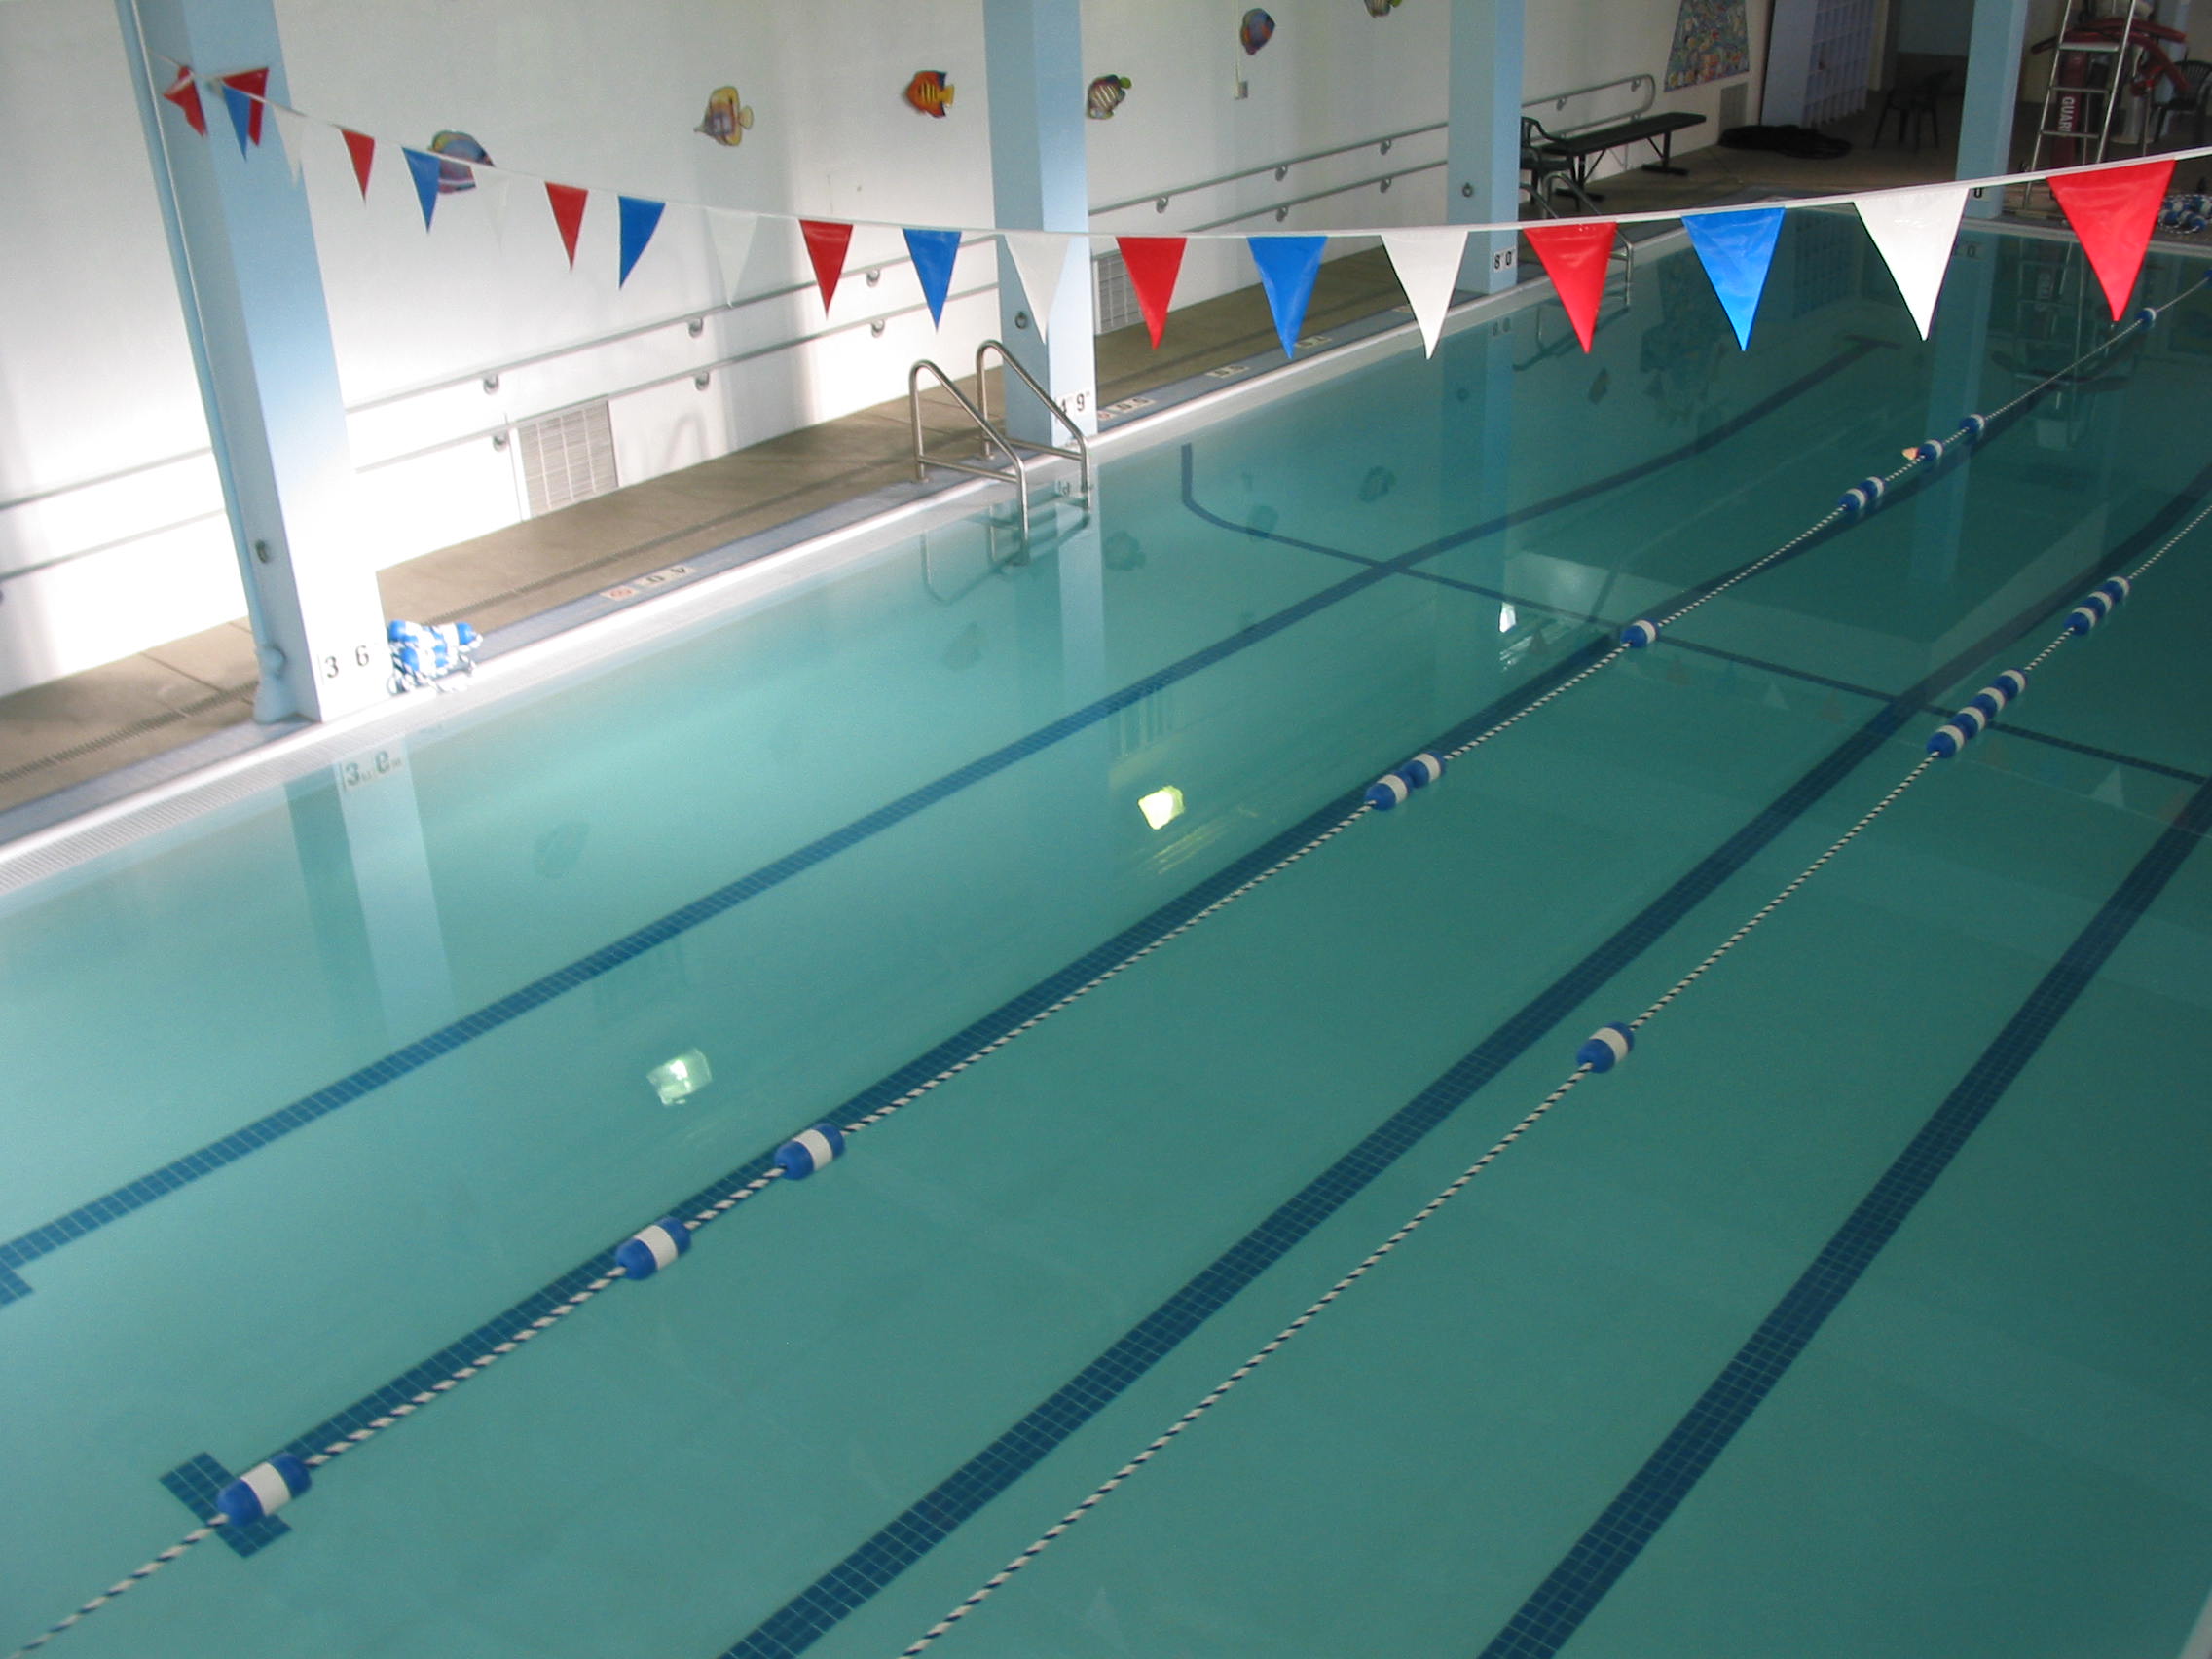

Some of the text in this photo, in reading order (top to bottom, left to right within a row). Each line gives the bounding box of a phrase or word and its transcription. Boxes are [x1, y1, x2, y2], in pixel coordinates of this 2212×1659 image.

[2057, 96, 2076, 132] GUAR
[1076, 393, 1086, 412] 9
[324, 645, 370, 679] 3 6
